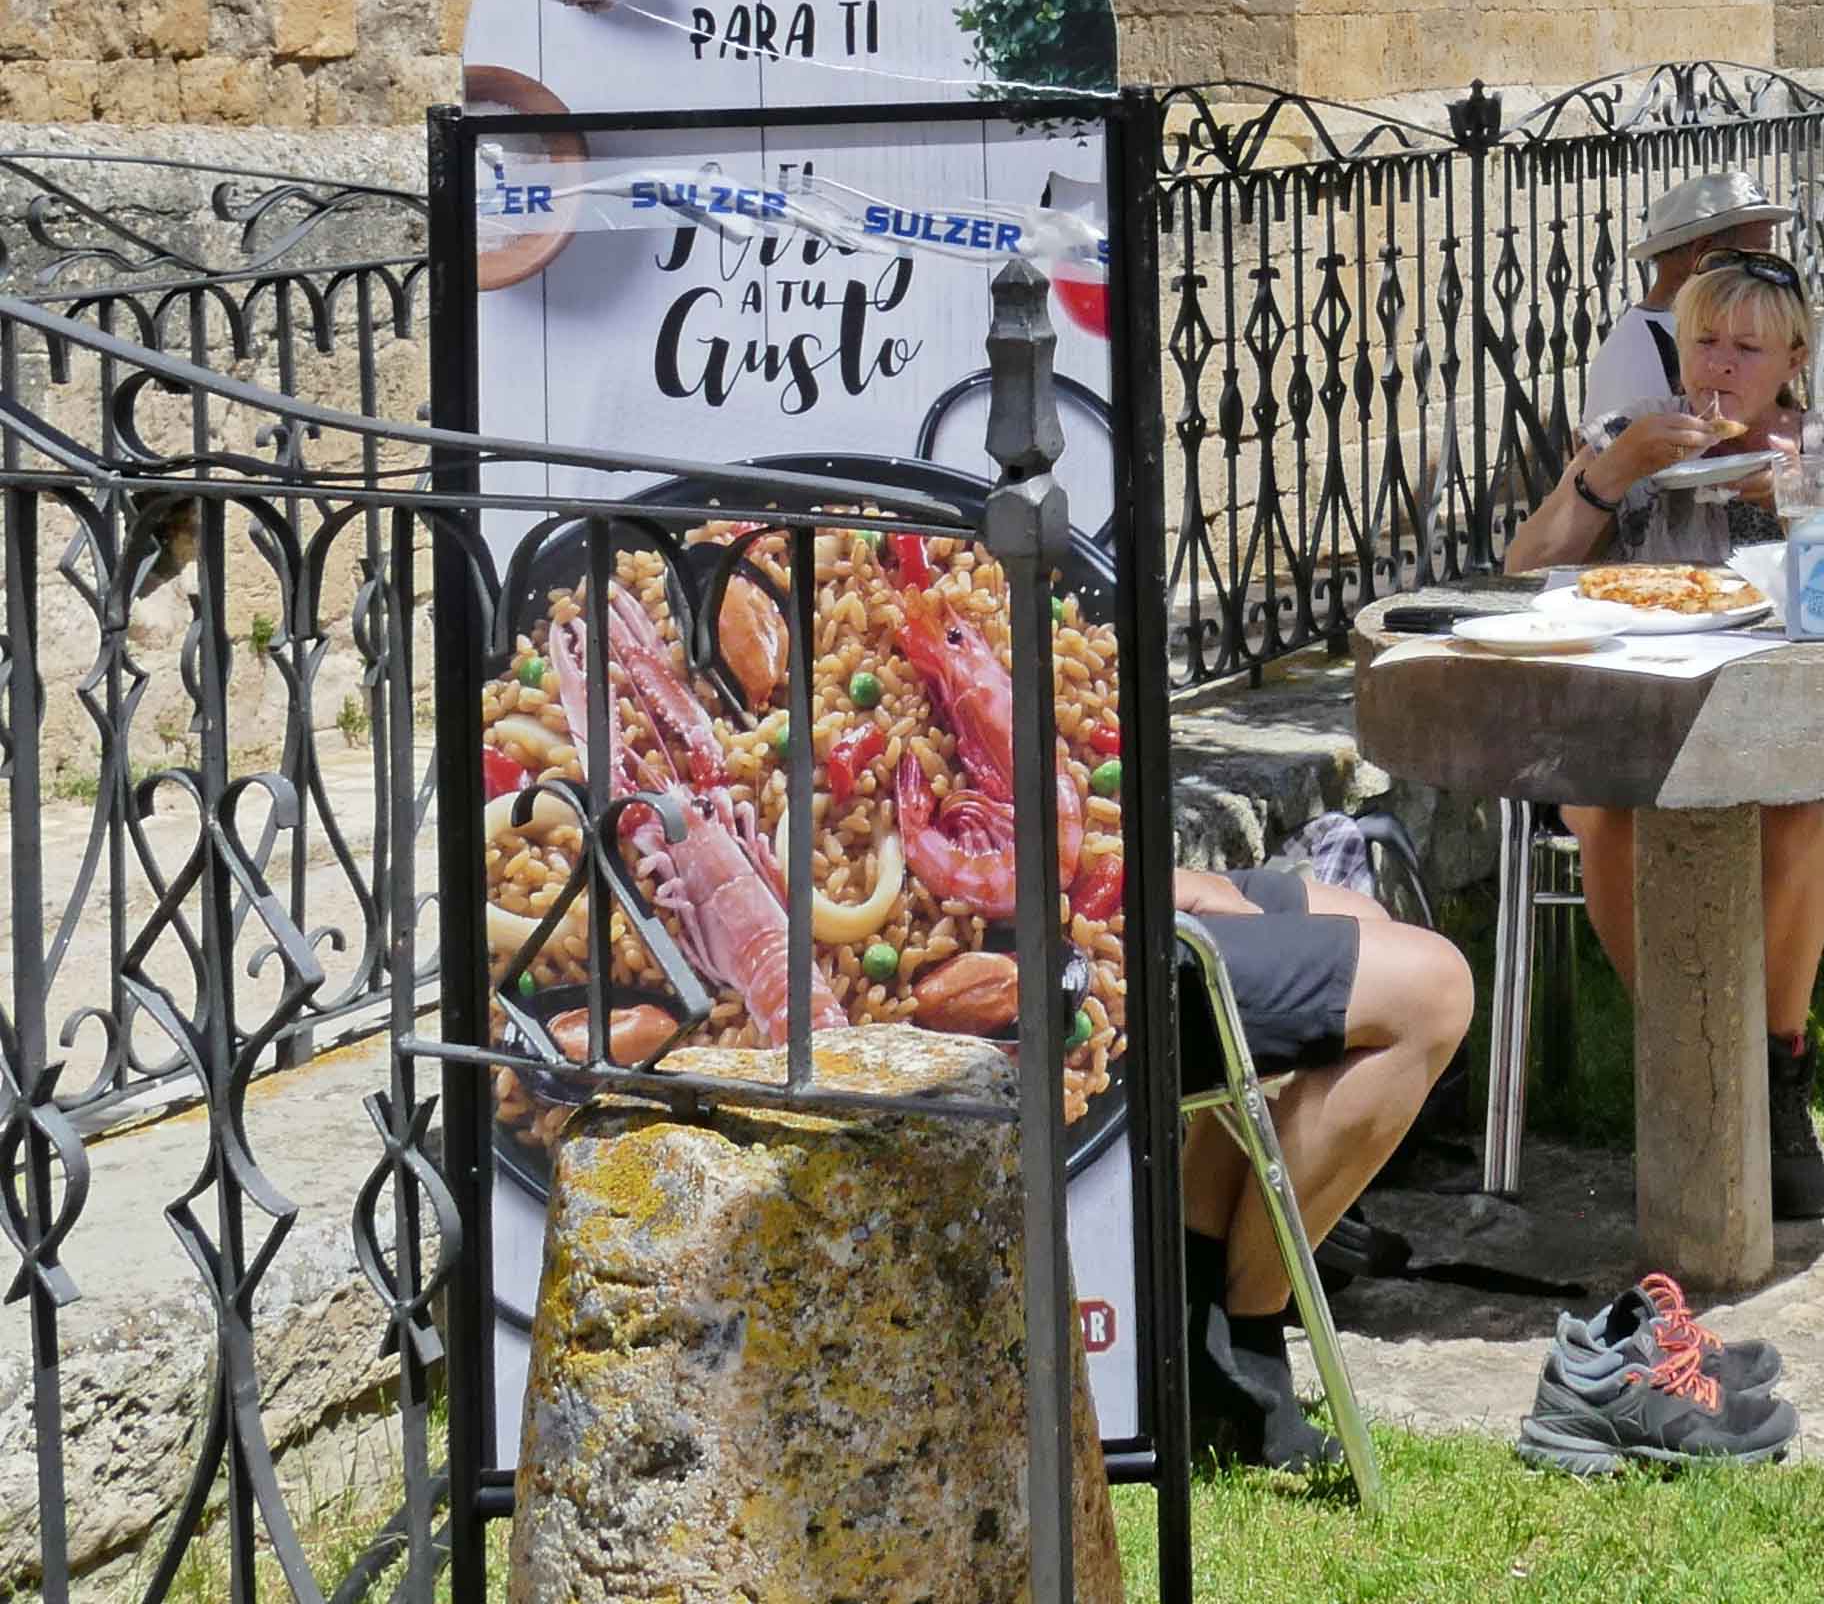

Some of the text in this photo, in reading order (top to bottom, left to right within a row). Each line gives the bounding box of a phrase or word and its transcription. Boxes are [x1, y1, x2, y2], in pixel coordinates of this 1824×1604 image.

[690, 0, 878, 62] PARA TI
[632, 181, 787, 218] SULZER
[864, 205, 1022, 253] SULZER
[741, 280, 826, 314] A TU
[655, 280, 924, 415] Gusto
